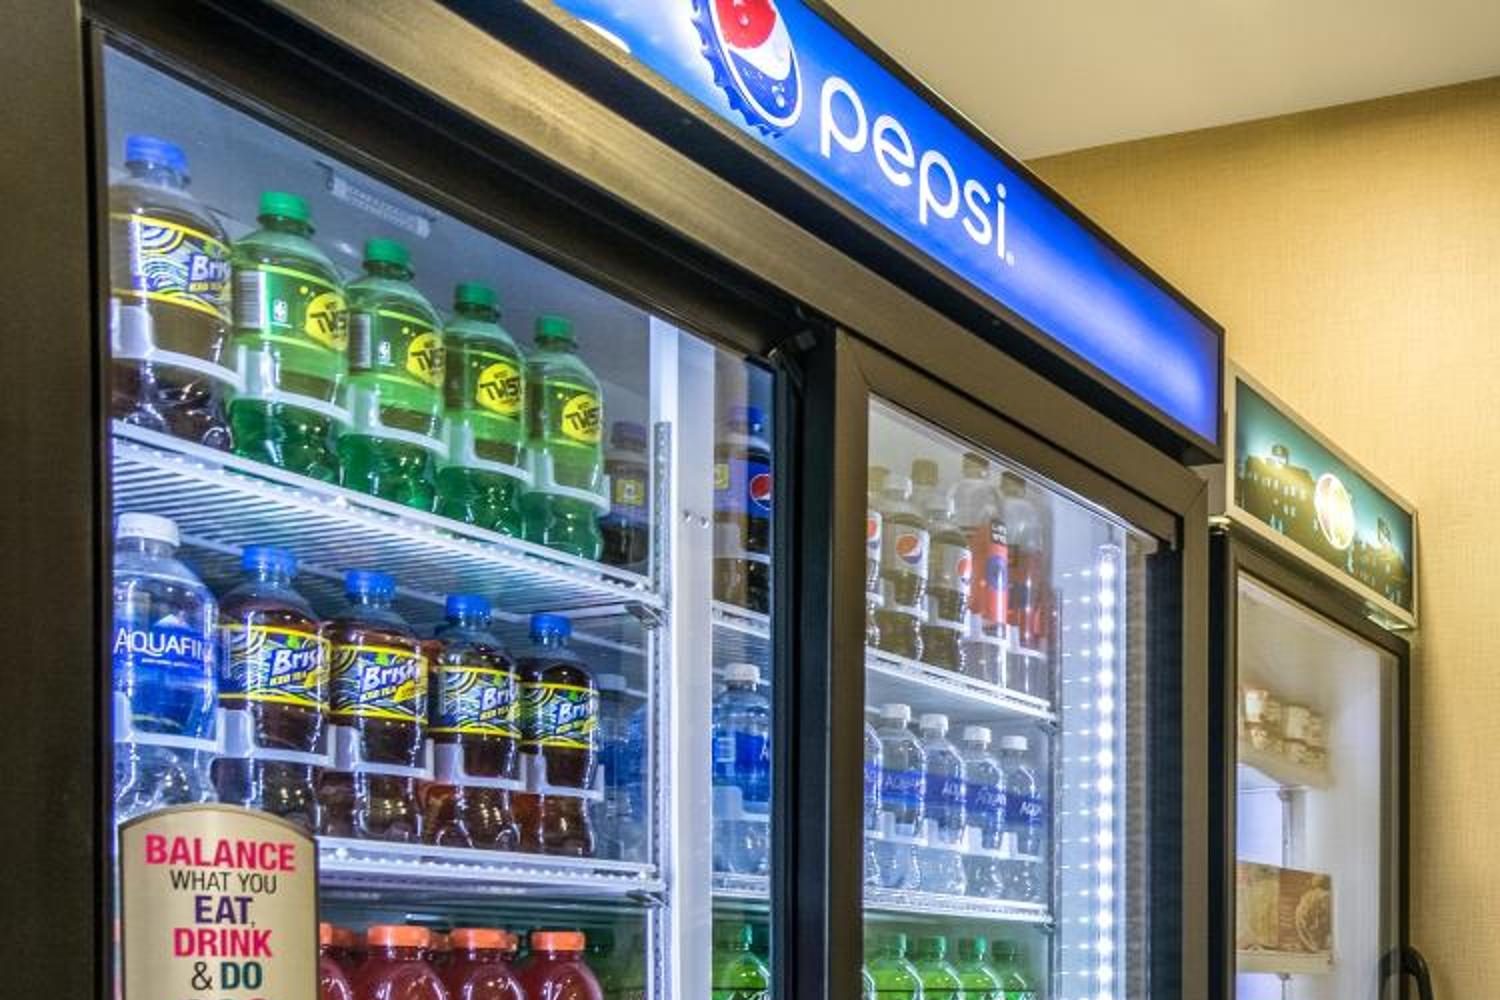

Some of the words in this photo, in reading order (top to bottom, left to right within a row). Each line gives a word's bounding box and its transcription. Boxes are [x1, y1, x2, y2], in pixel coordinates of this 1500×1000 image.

[819, 75, 1007, 259] pepsi
[145, 834, 296, 872] BALANCE
[170, 870, 230, 893] WHAT
[238, 872, 278, 895] YOU
[173, 928, 274, 958] DRINK
[191, 961, 213, 991] &
[221, 961, 263, 991] DO
